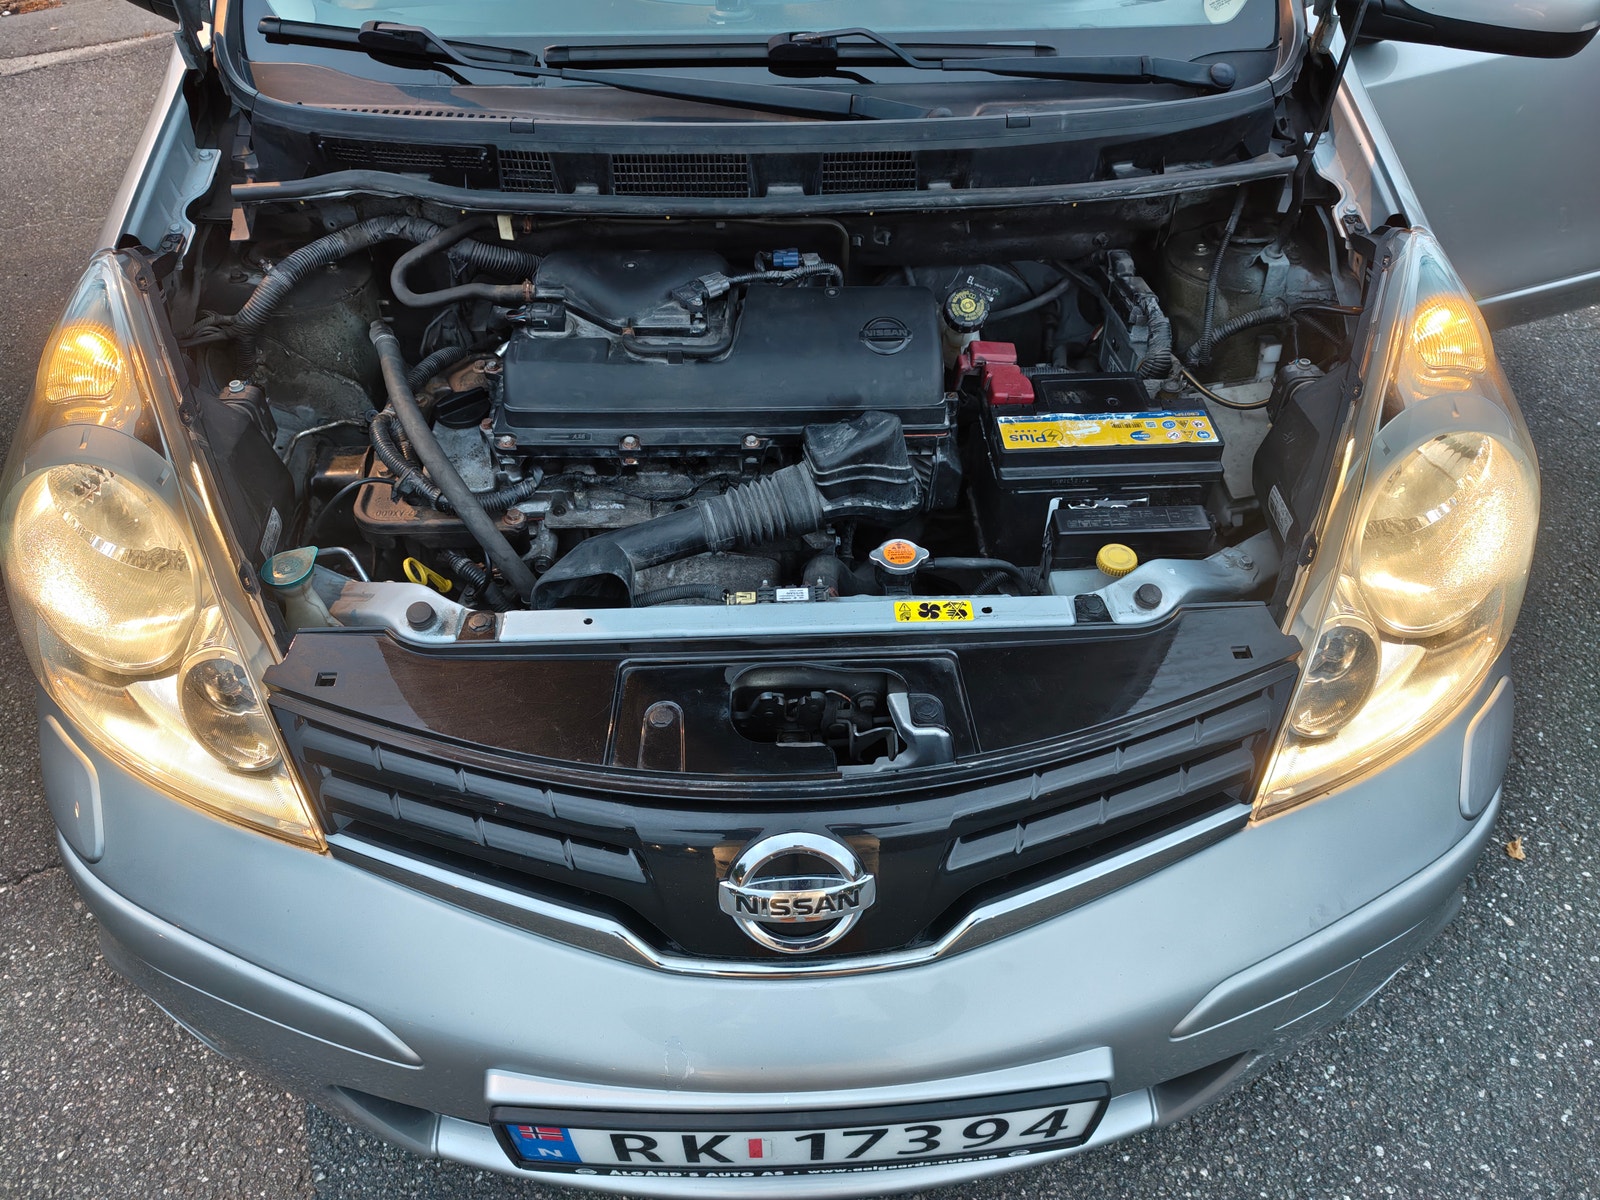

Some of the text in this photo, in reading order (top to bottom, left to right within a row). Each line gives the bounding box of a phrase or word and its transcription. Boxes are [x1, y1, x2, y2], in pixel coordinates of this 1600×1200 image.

[864, 329, 908, 337] NISSAN
[1009, 433, 1047, 443] Plus
[735, 889, 860, 916] NISSAN
[609, 1108, 1069, 1163] RK 17394
[537, 1147, 563, 1158] N
